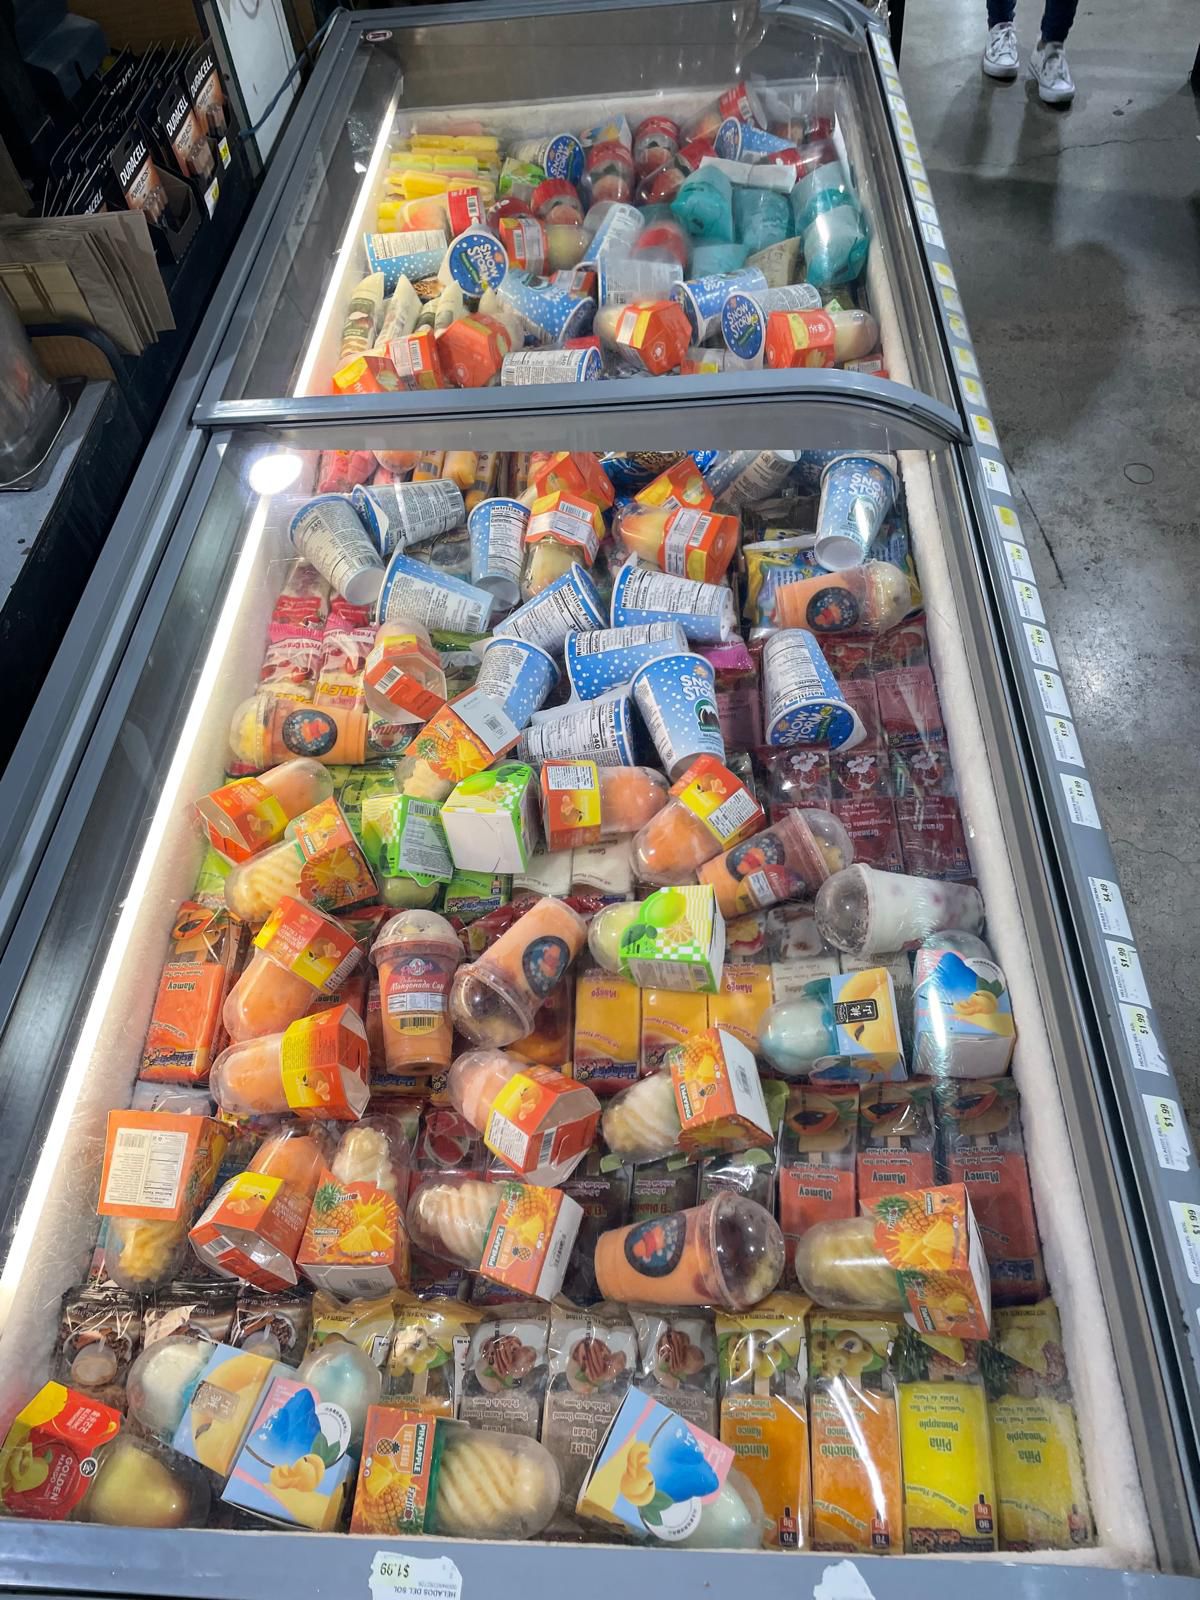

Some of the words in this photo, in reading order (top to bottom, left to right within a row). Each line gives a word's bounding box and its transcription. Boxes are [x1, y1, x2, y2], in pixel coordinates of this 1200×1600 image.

[190, 56, 213, 98] DURACELL
[166, 95, 189, 137] DURACELL
[120, 141, 147, 187] DURACELL
[478, 243, 498, 278] SNOW
[727, 304, 748, 325] SNOW
[567, 582, 584, 613] Nutrition
[622, 572, 635, 609] Nutrition
[680, 675, 712, 690] SNO
[780, 711, 804, 745] SNOW
[799, 712, 826, 744] TORM
[592, 732, 601, 751] 340
[1100, 883, 1112, 903] $4.49
[1118, 947, 1129, 968] $1.99
[167, 982, 195, 992] Mamey
[391, 981, 430, 992] Mangonada
[591, 987, 617, 999] Mango
[727, 982, 752, 993] Mango
[1137, 1013, 1149, 1035] $1.99
[1160, 1103, 1174, 1127] $1.99
[872, 1171, 907, 1185] Mamey
[964, 1170, 1001, 1184] Mamey
[799, 1186, 833, 1201] Mamey
[1187, 1209, 1200, 1235] $1.99
[488, 1226, 505, 1267] PINEAPPLE
[573, 1427, 597, 1439] Pecan
[737, 1426, 762, 1437] Nance
[919, 1420, 959, 1432] Pineapple
[413, 1424, 426, 1475] PINEAPPLE
[570, 1443, 595, 1459] Nuez
[929, 1437, 952, 1452] Piña
[1018, 1449, 1042, 1464] Piña
[50, 1453, 66, 1484] MANGO
[51, 1456, 72, 1502] GOLDEN
[783, 1518, 793, 1529] 0g
[979, 1519, 989, 1529] 90
[784, 1533, 794, 1543] 70
[874, 1532, 886, 1545] 70
[380, 1562, 410, 1578] $1.99
[410, 1587, 422, 1595] DEL
[424, 1589, 457, 1598] HELADOS
